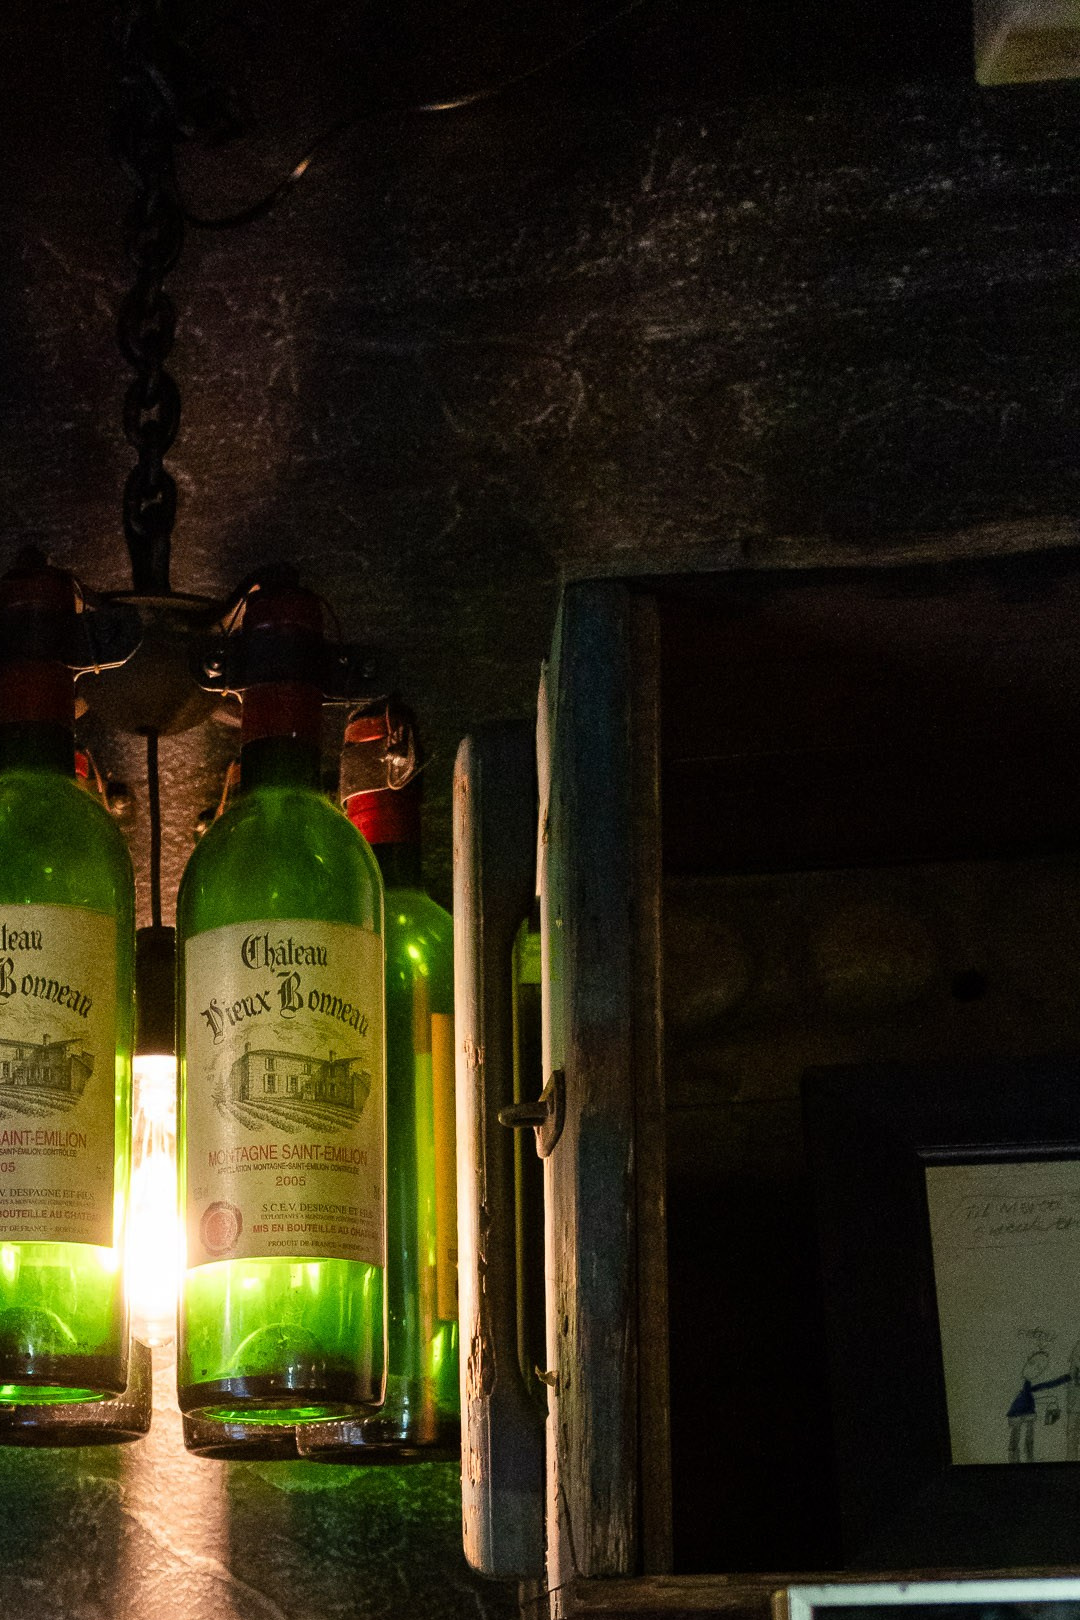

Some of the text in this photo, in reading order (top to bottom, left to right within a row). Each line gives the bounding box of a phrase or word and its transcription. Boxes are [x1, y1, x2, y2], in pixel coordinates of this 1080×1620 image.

[241, 931, 328, 973] Château
[200, 989, 272, 1045] Vieux
[208, 1145, 278, 1167] MONTAGNE
[275, 1175, 306, 1187] 2005
[9, 1188, 61, 1200] DESPAGNE
[49, 1210, 63, 1219] AU
[299, 1203, 347, 1215] DESPAGNE
[348, 1206, 359, 1216] ET
[252, 1224, 269, 1234] MIS
[271, 1224, 284, 1233] EN
[286, 1223, 336, 1234] BOUTEILLE
[337, 1226, 349, 1235] AU
